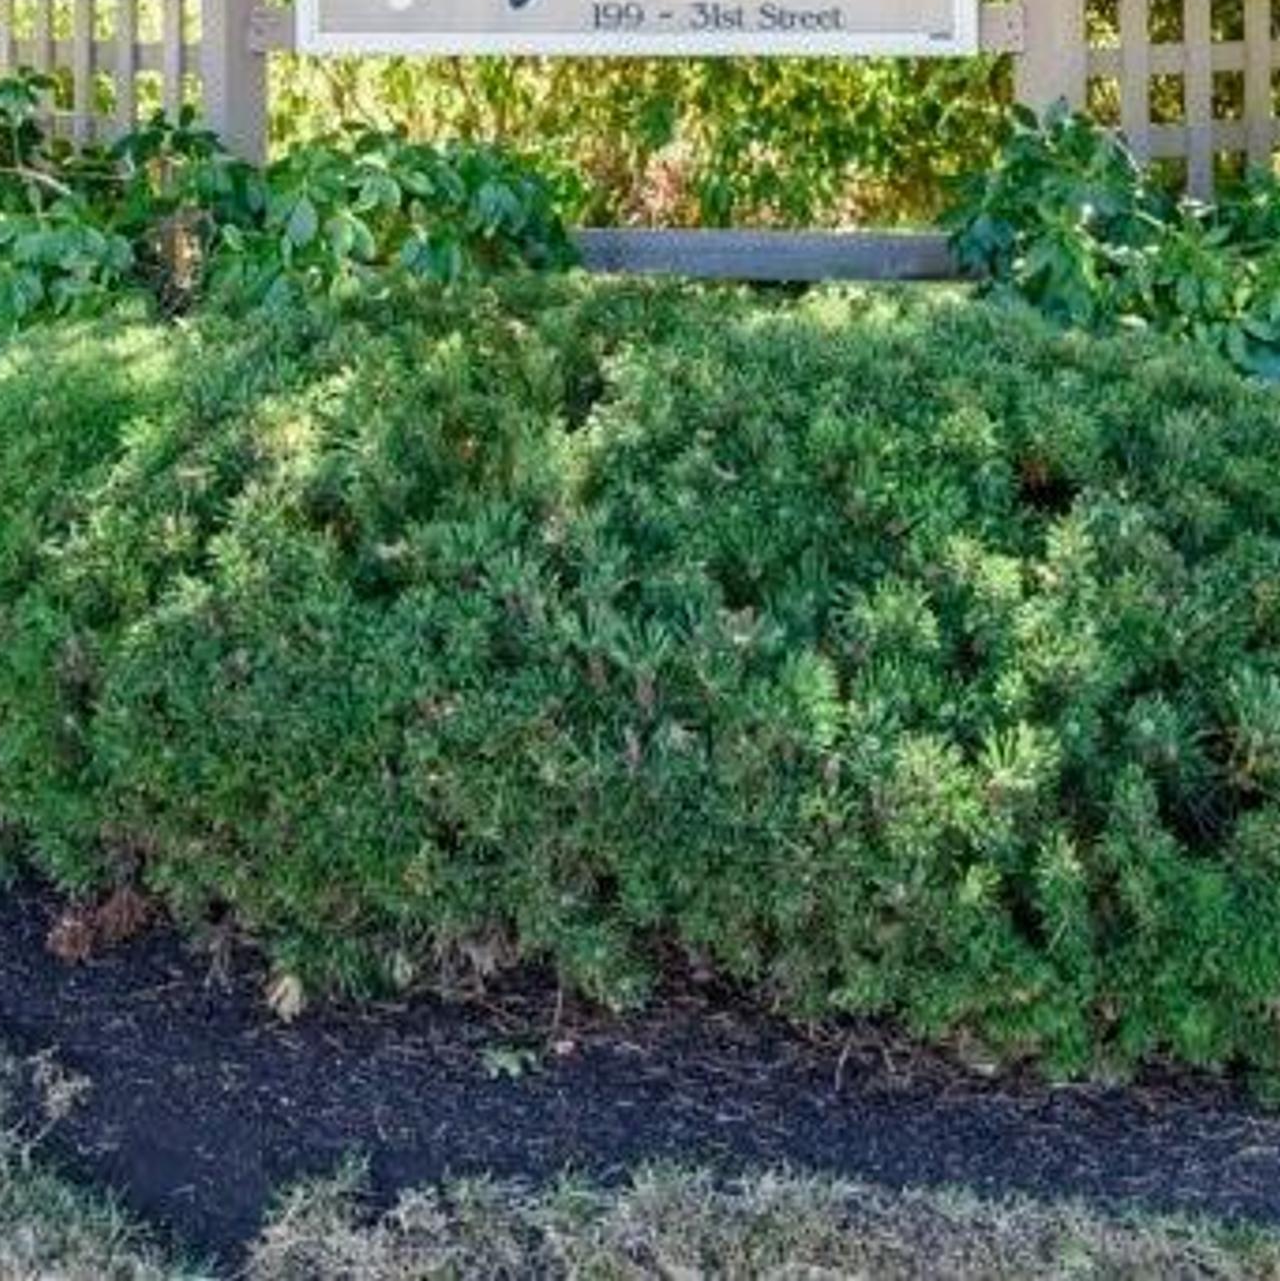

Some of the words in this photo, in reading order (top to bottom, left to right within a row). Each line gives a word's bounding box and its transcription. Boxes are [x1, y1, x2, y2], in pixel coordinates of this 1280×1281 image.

[591, 3, 644, 30] 199
[689, 3, 744, 30] 31st
[758, 2, 844, 30] Street
